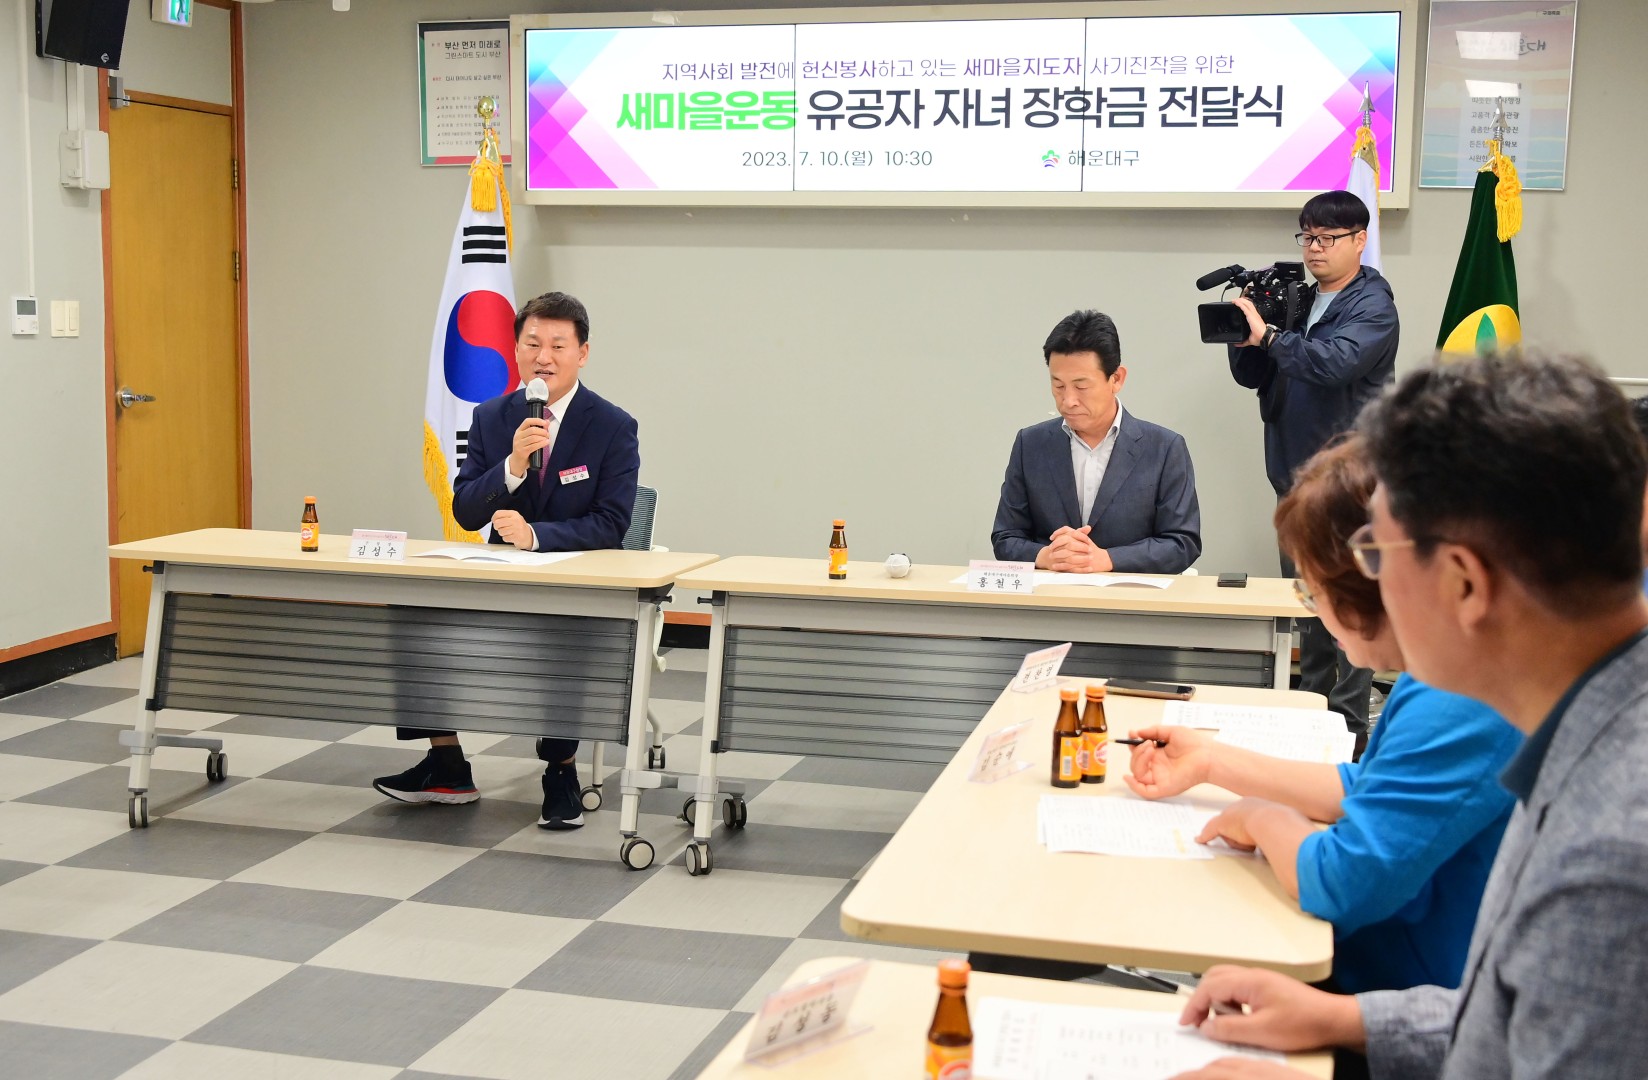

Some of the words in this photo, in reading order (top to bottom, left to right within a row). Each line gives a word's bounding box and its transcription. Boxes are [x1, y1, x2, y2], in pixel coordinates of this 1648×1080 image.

[445, 41, 459, 50] 부산
[462, 41, 476, 50] 먼저
[479, 40, 501, 49] 미래로
[662, 63, 734, 81] 지역사회
[740, 62, 793, 80] 발전에
[802, 59, 914, 79] 헌신봉사하고
[920, 58, 957, 77] 있는
[963, 56, 1082, 77] 새마을지도자
[1090, 55, 1188, 75] 사기진작을
[1195, 54, 1235, 75] 위한
[616, 90, 799, 130] 새마을운동
[807, 88, 925, 130] 유공자
[933, 88, 1011, 129] 자녀
[1022, 86, 1148, 128] 장학금
[1158, 84, 1284, 128] 전달식
[742, 151, 791, 167] 2023.
[799, 151, 813, 167] 7.
[820, 150, 873, 167] 10.(월)
[885, 151, 933, 166] 10:30
[1068, 150, 1140, 167] 해운대구
